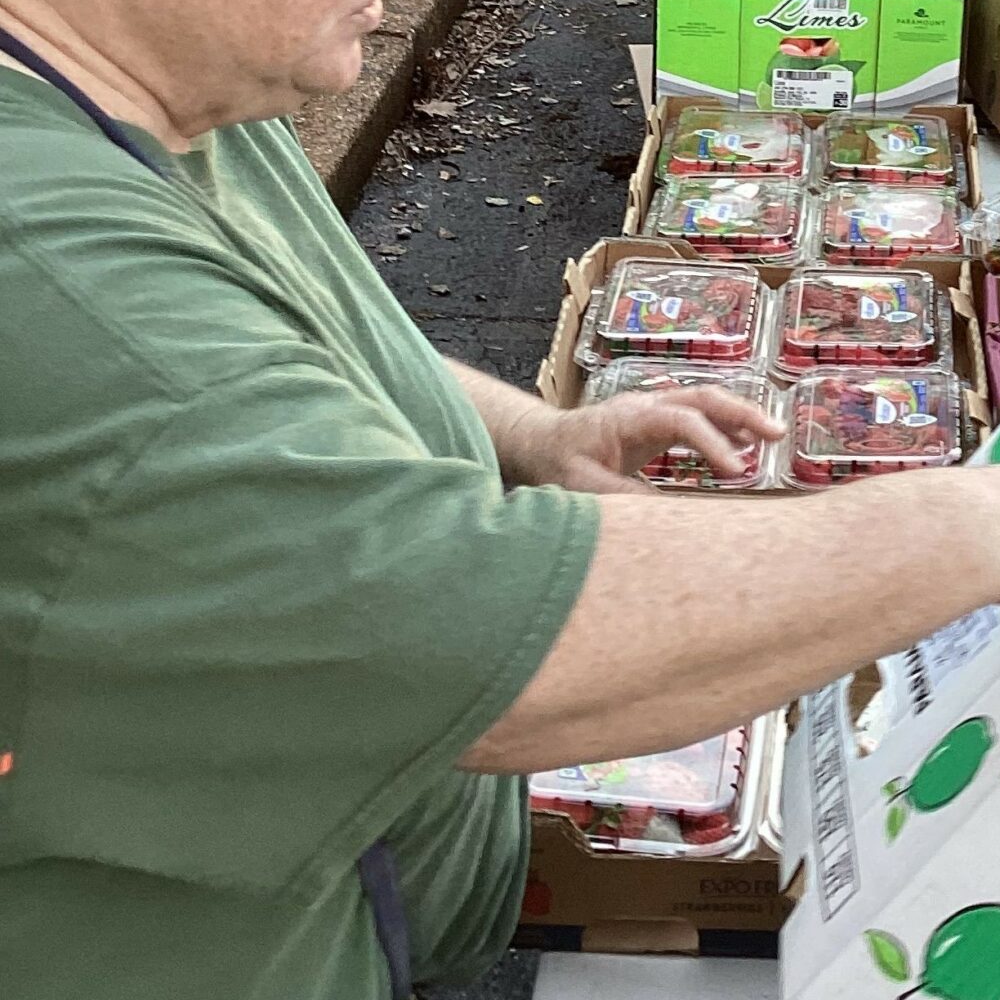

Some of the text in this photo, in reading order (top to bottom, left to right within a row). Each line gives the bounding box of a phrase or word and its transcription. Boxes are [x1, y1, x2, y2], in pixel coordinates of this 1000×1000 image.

[896, 18, 946, 27] PARAMOUNT
[700, 879, 778, 894] EXPO FR
